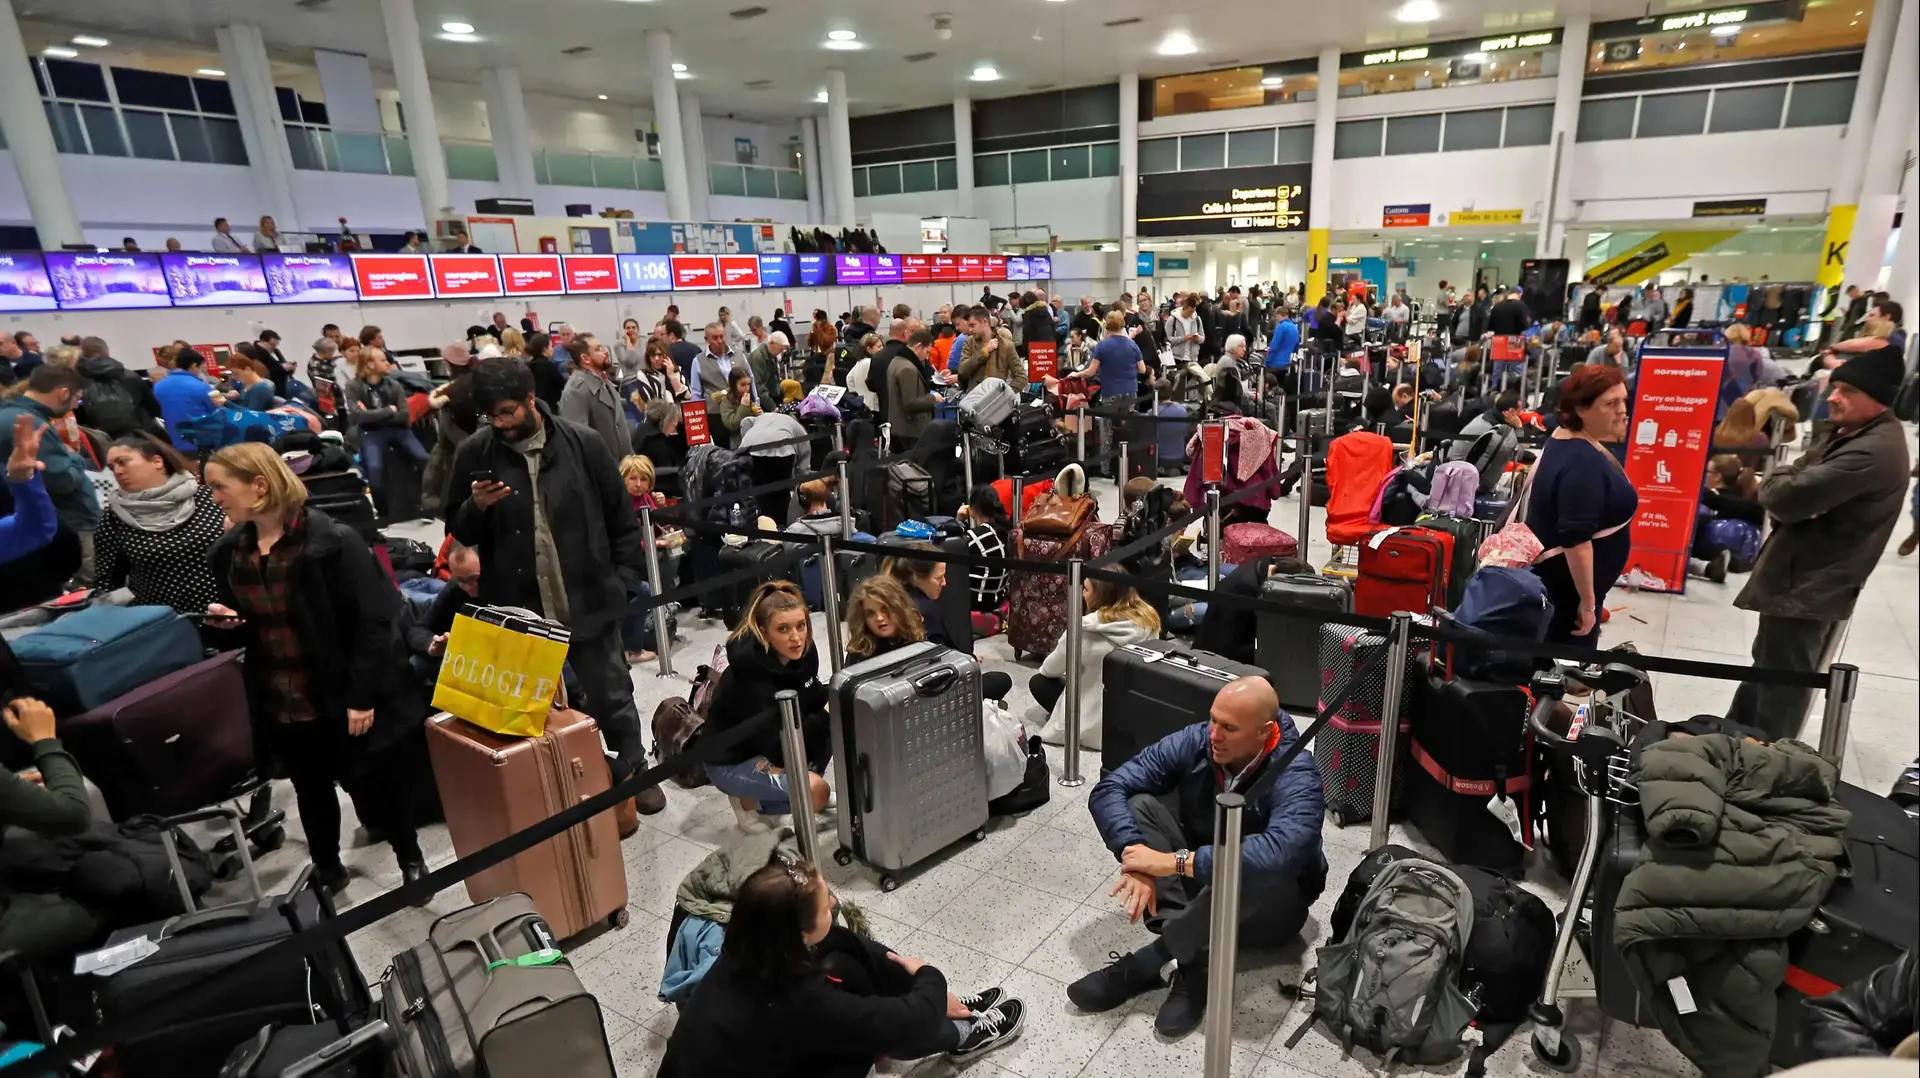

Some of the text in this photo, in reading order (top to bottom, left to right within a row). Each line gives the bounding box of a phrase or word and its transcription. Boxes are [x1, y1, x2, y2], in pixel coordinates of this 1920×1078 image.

[1232, 187, 1277, 201] Departures
[1252, 216, 1275, 227] Hotel
[1826, 240, 1849, 266] K
[1309, 254, 1318, 272] J
[444, 270, 489, 281] norwegian
[512, 269, 552, 279] norwegian
[622, 261, 669, 280] 11:06
[368, 272, 418, 282] norwegian
[1654, 368, 1707, 378] norwegian
[1642, 394, 1664, 404] Carry
[1676, 396, 1708, 405] baggage
[1655, 404, 1694, 413] allowance
[1655, 513, 1668, 521] fits,
[1638, 520, 1670, 529] you're in.
